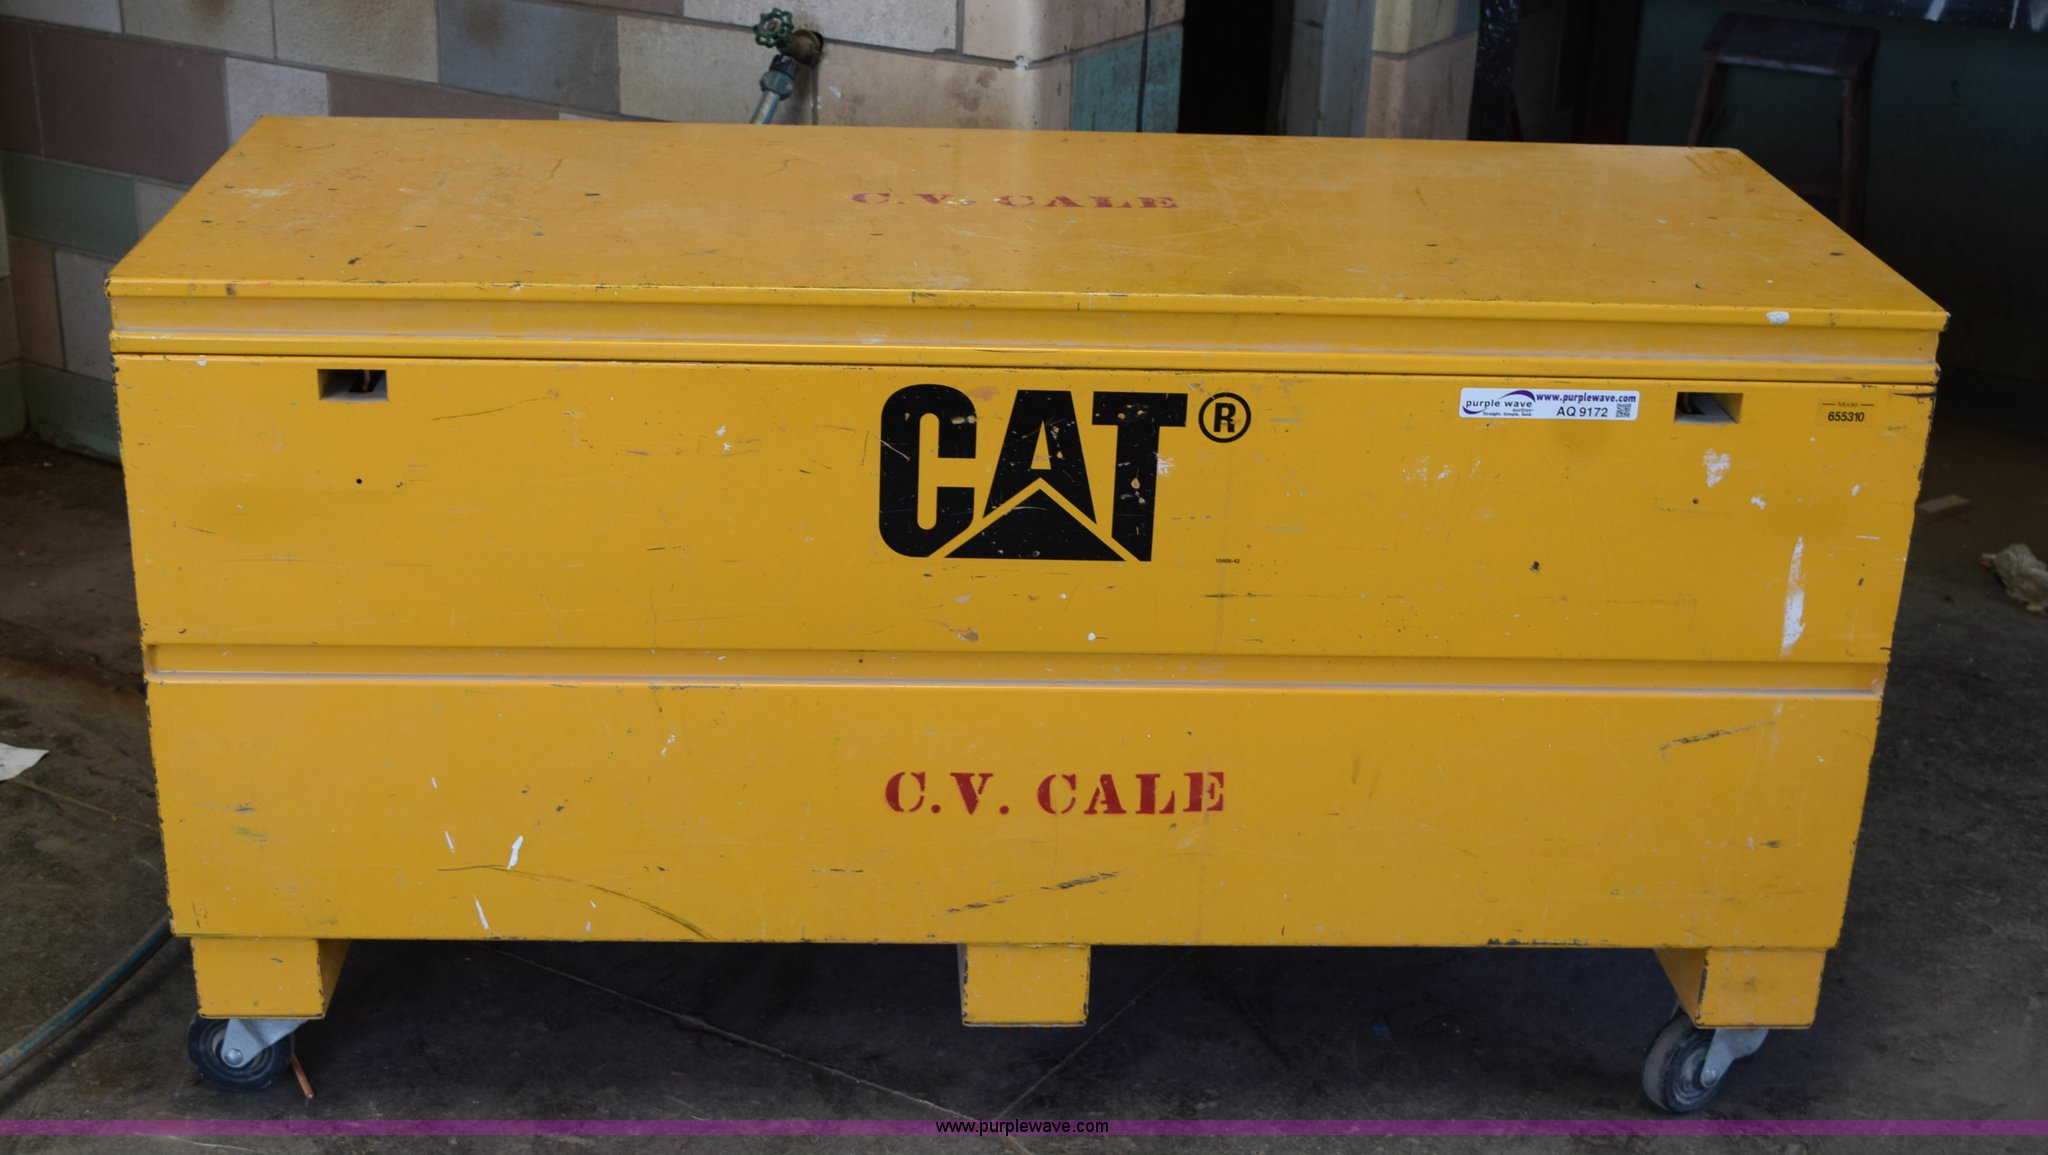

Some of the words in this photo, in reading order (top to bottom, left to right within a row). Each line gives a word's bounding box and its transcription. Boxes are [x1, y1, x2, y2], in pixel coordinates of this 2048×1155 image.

[998, 194, 1178, 209] CALE
[1466, 399, 1500, 408] purple
[1536, 392, 1636, 404] www.purplewave.com
[1556, 406, 1576, 416] AQ
[1579, 407, 1608, 417] 9172
[1828, 411, 1865, 422] 655310
[879, 383, 1188, 562] CAT
[885, 771, 1010, 815] C.V.
[1037, 771, 1225, 815] CALE
